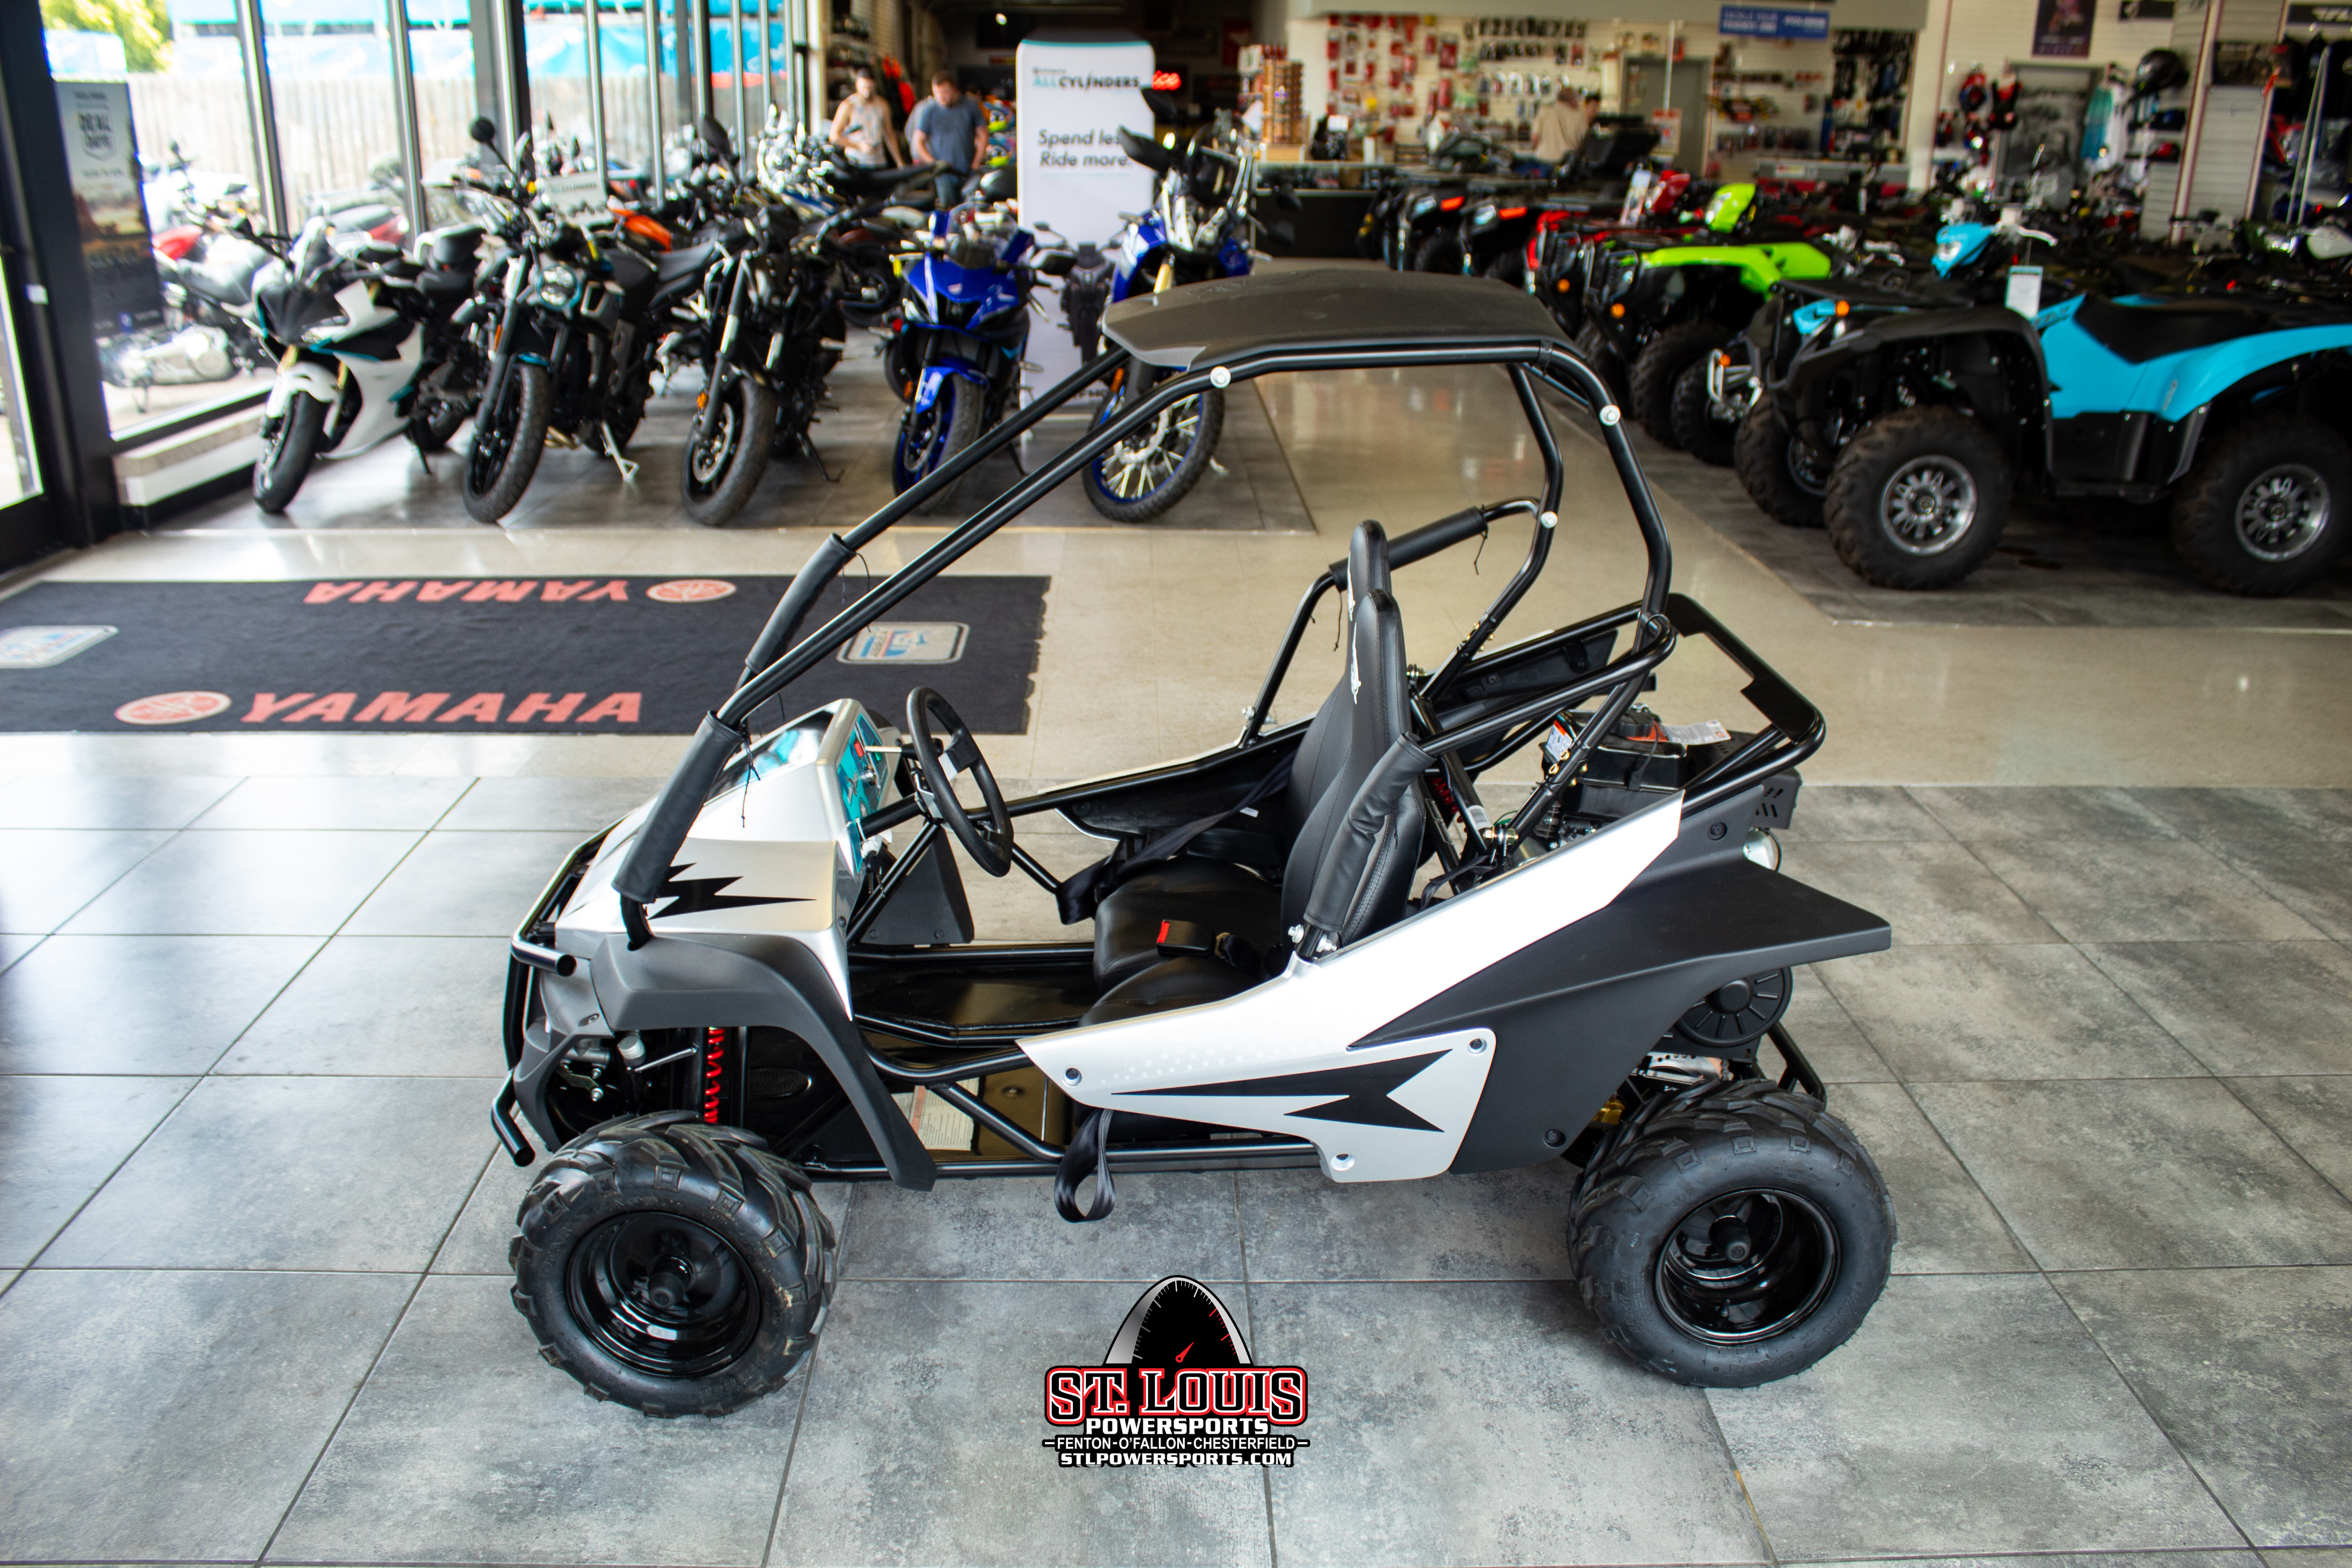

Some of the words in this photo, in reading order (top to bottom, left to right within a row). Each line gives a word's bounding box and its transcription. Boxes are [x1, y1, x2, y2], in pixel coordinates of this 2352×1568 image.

[1039, 129, 1094, 150] Spend
[1099, 129, 1121, 145] les
[1040, 150, 1078, 167] Ride
[1083, 156, 1132, 167] more.
[304, 581, 627, 603] YAMAHA
[242, 692, 641, 722] YAMAHA
